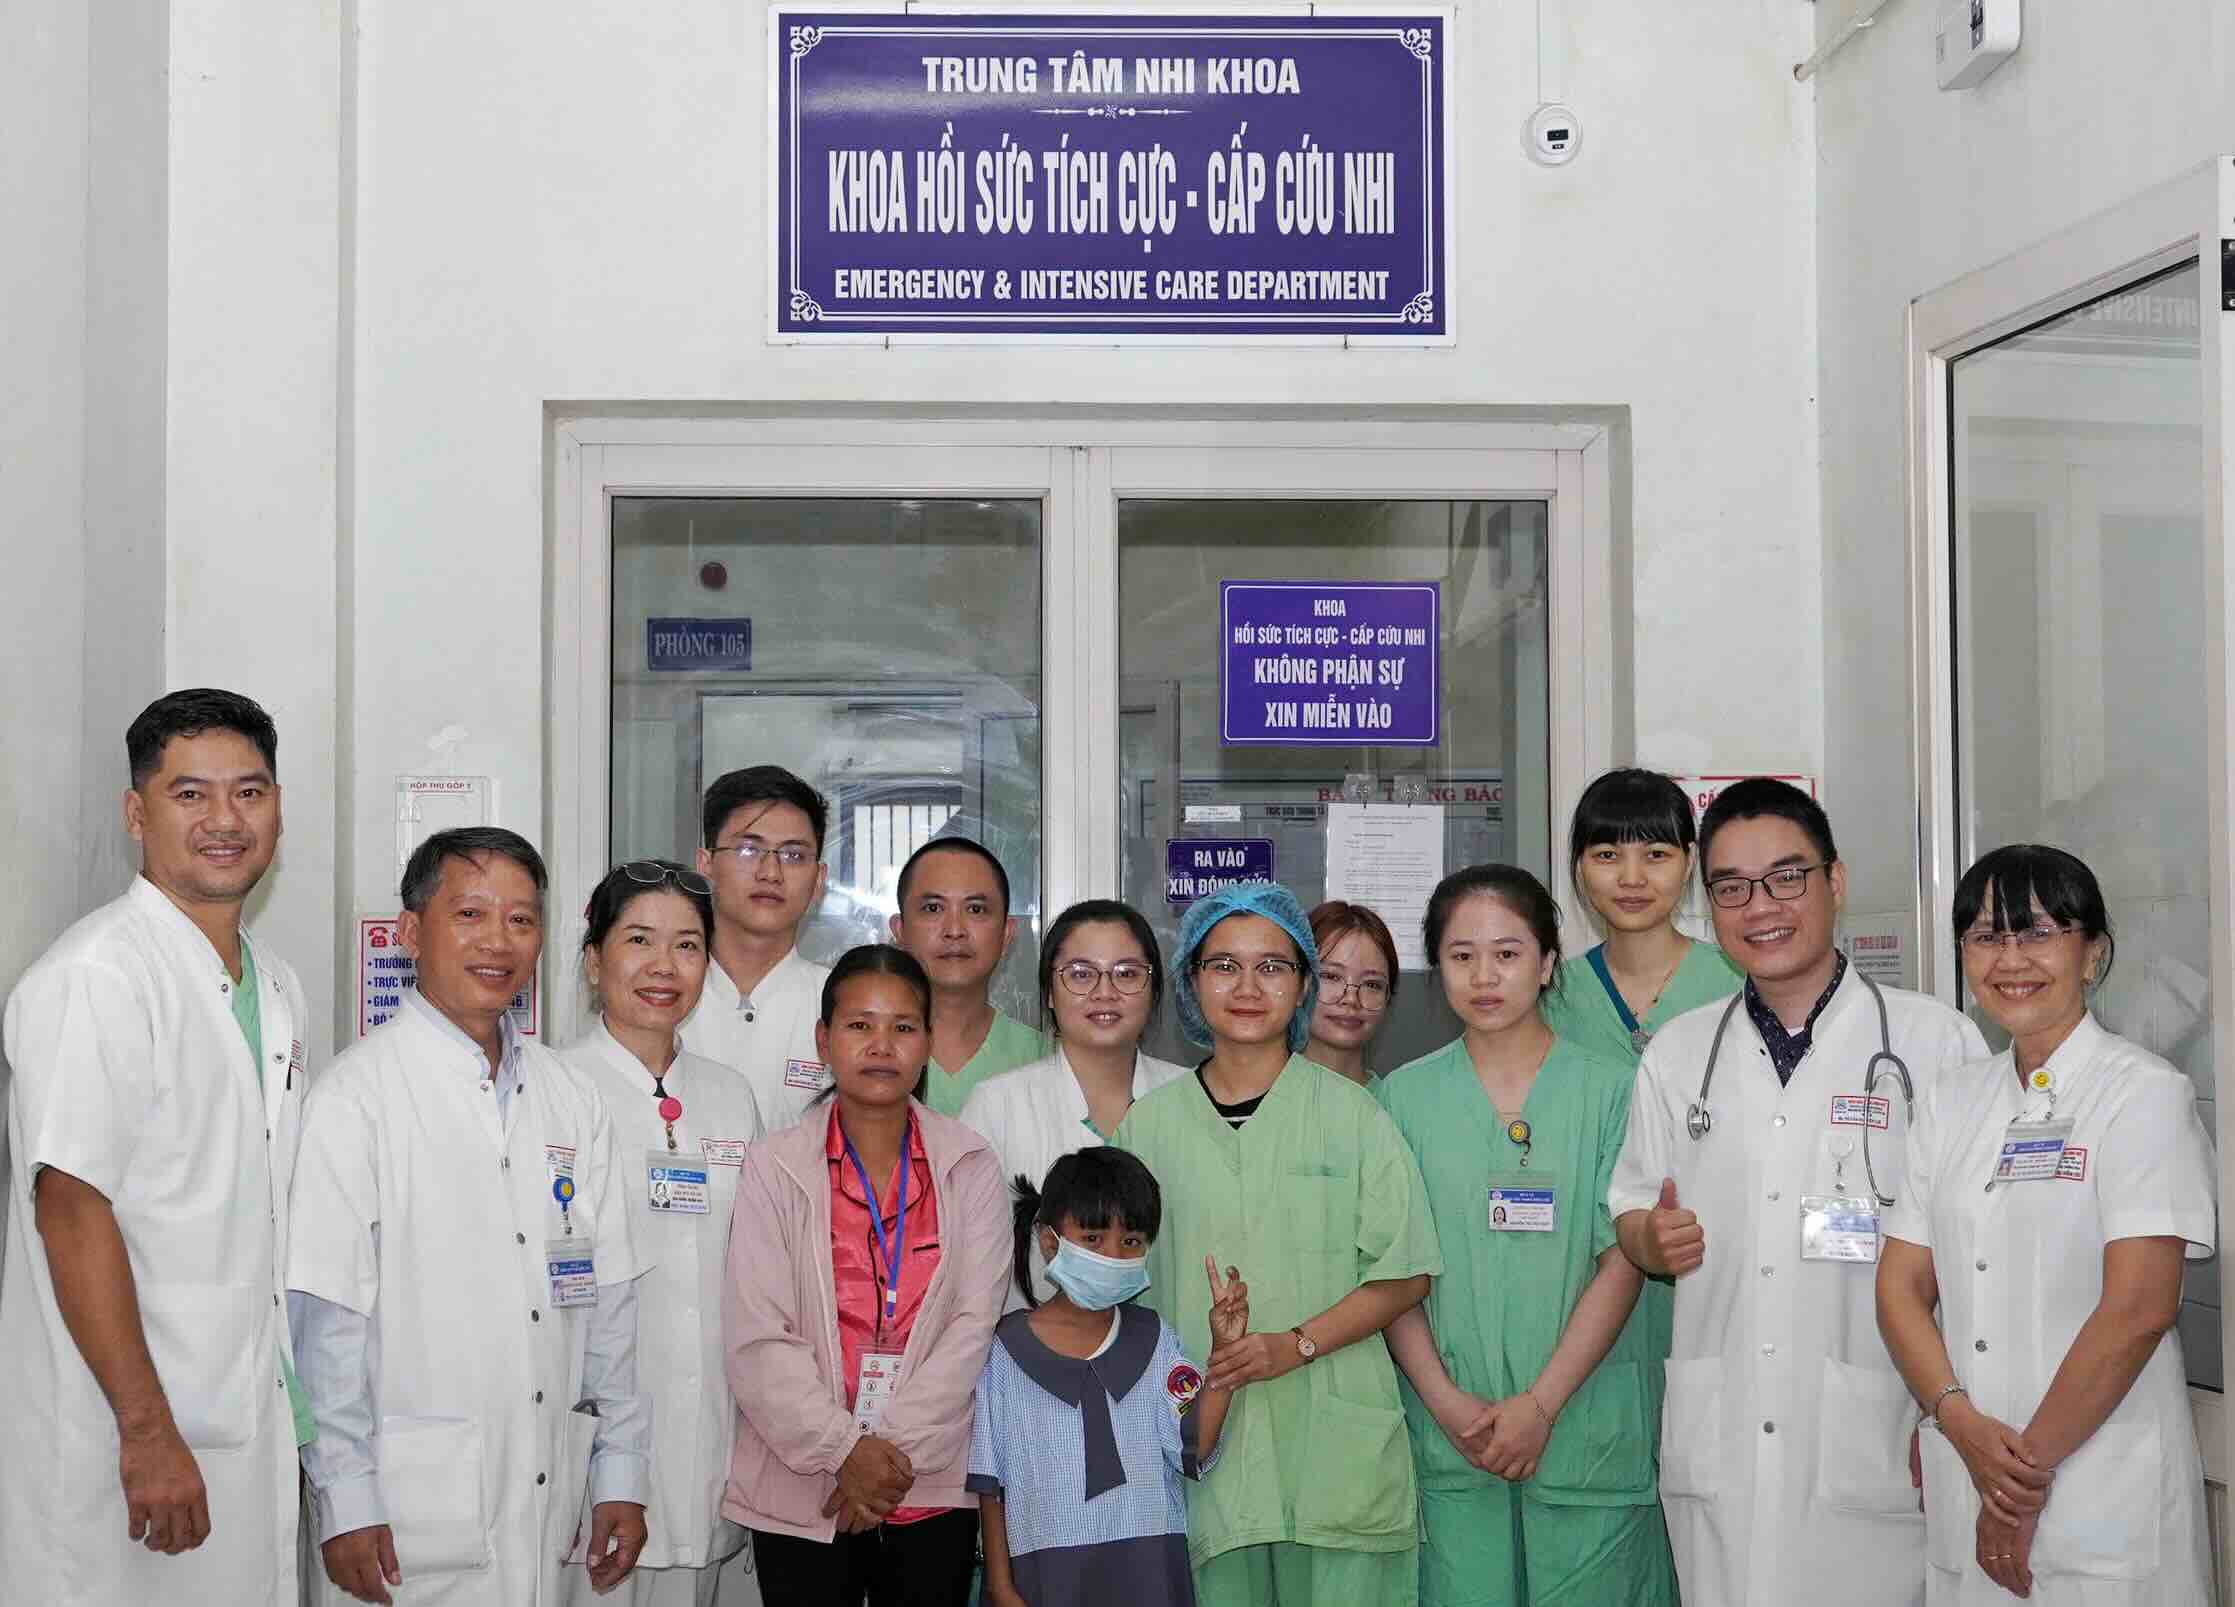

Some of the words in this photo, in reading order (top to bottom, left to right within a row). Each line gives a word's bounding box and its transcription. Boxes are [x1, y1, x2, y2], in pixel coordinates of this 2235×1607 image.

[922, 57, 1037, 94] TRUNG
[1048, 50, 1123, 94] TÂM
[1135, 58, 1194, 94] NHI
[1207, 58, 1300, 94] KHOA
[828, 150, 908, 234] KHOA
[917, 121, 965, 234] HỒI
[975, 132, 1034, 235] SỨC
[1043, 133, 1108, 235] TÍCH
[1118, 143, 1177, 253] CỰC
[1207, 121, 1266, 235] CẤP
[1275, 134, 1334, 235] CỨU
[1344, 152, 1395, 234] NHI
[835, 269, 984, 300] EMERGENCY
[993, 270, 1012, 300] &
[1020, 270, 1148, 300] INTENSIVE
[1155, 270, 1218, 300] CARE
[1228, 270, 1390, 301] DEPARTMENT
[1314, 599, 1347, 617] KHOA
[655, 624, 716, 657] PHÒNG
[721, 634, 745, 657] 105
[1258, 624, 1282, 645] SỨC
[1285, 624, 1312, 645] TÍCH
[1314, 626, 1339, 649] CỰC
[1350, 622, 1375, 646] CẤP
[1405, 628, 1426, 646] NHI
[1254, 653, 1317, 685] KHÔNG
[1322, 654, 1374, 691] PHẬN
[1378, 657, 1406, 691] SỰ
[1264, 702, 1298, 728] XIN
[1302, 694, 1351, 729] MIỄN
[1355, 698, 1392, 729] VÀO
[1194, 850, 1214, 867] RA
[1217, 848, 1246, 868] VÀO
[1169, 877, 1195, 896] XIN
[373, 976, 399, 991] TRỰC
[373, 993, 400, 1008] GIÁM
